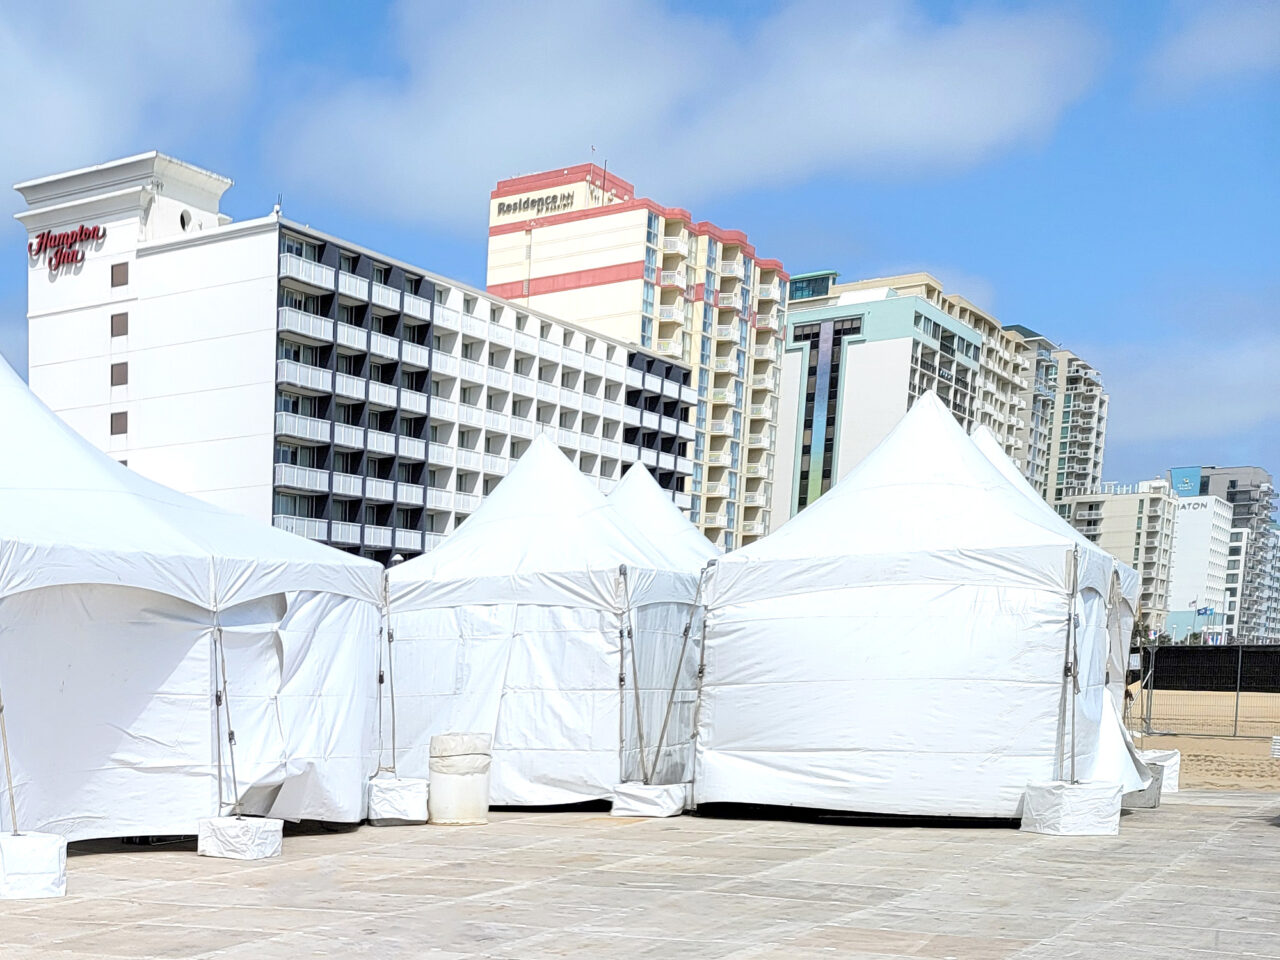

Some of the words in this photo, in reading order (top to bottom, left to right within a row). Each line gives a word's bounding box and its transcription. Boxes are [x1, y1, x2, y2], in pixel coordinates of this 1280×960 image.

[497, 194, 558, 216] Residence
[28, 224, 107, 256] Hampton
[48, 245, 86, 271] Inn
